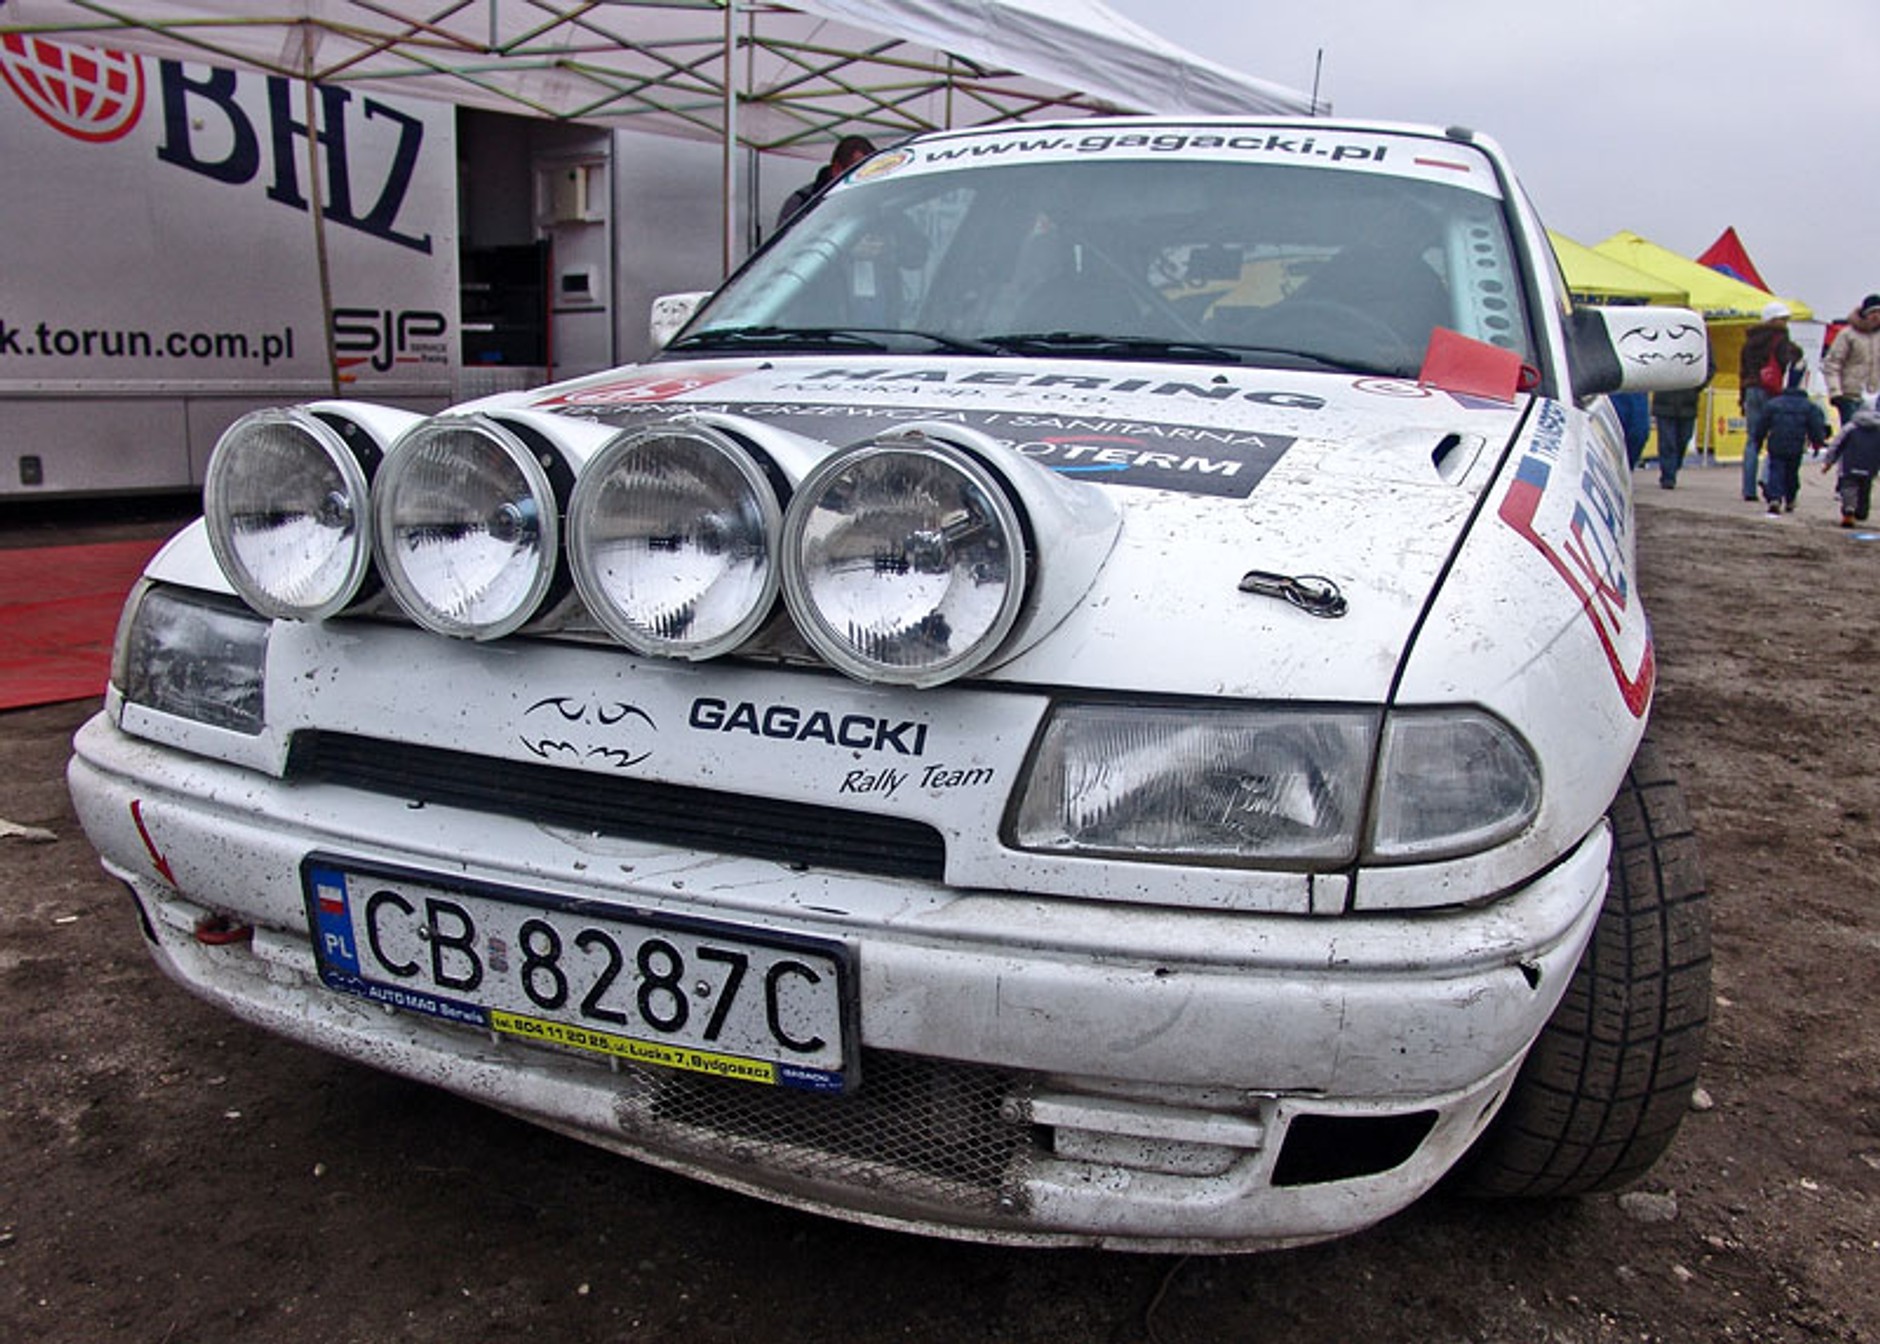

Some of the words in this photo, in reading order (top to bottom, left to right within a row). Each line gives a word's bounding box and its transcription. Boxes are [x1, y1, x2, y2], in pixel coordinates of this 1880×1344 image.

[926, 132, 1388, 163] www.gagacki.pl
[0, 319, 294, 367] k.torun.com.pl
[332, 308, 448, 373] SJP
[803, 367, 1327, 410] HAERING
[1007, 415, 1268, 449] SANITARNA
[688, 697, 928, 756] GAGACKI
[838, 767, 910, 799] Rally
[919, 763, 995, 789] Team
[323, 933, 354, 961] PL
[365, 889, 484, 992] CB
[518, 917, 828, 1054] 8287C
